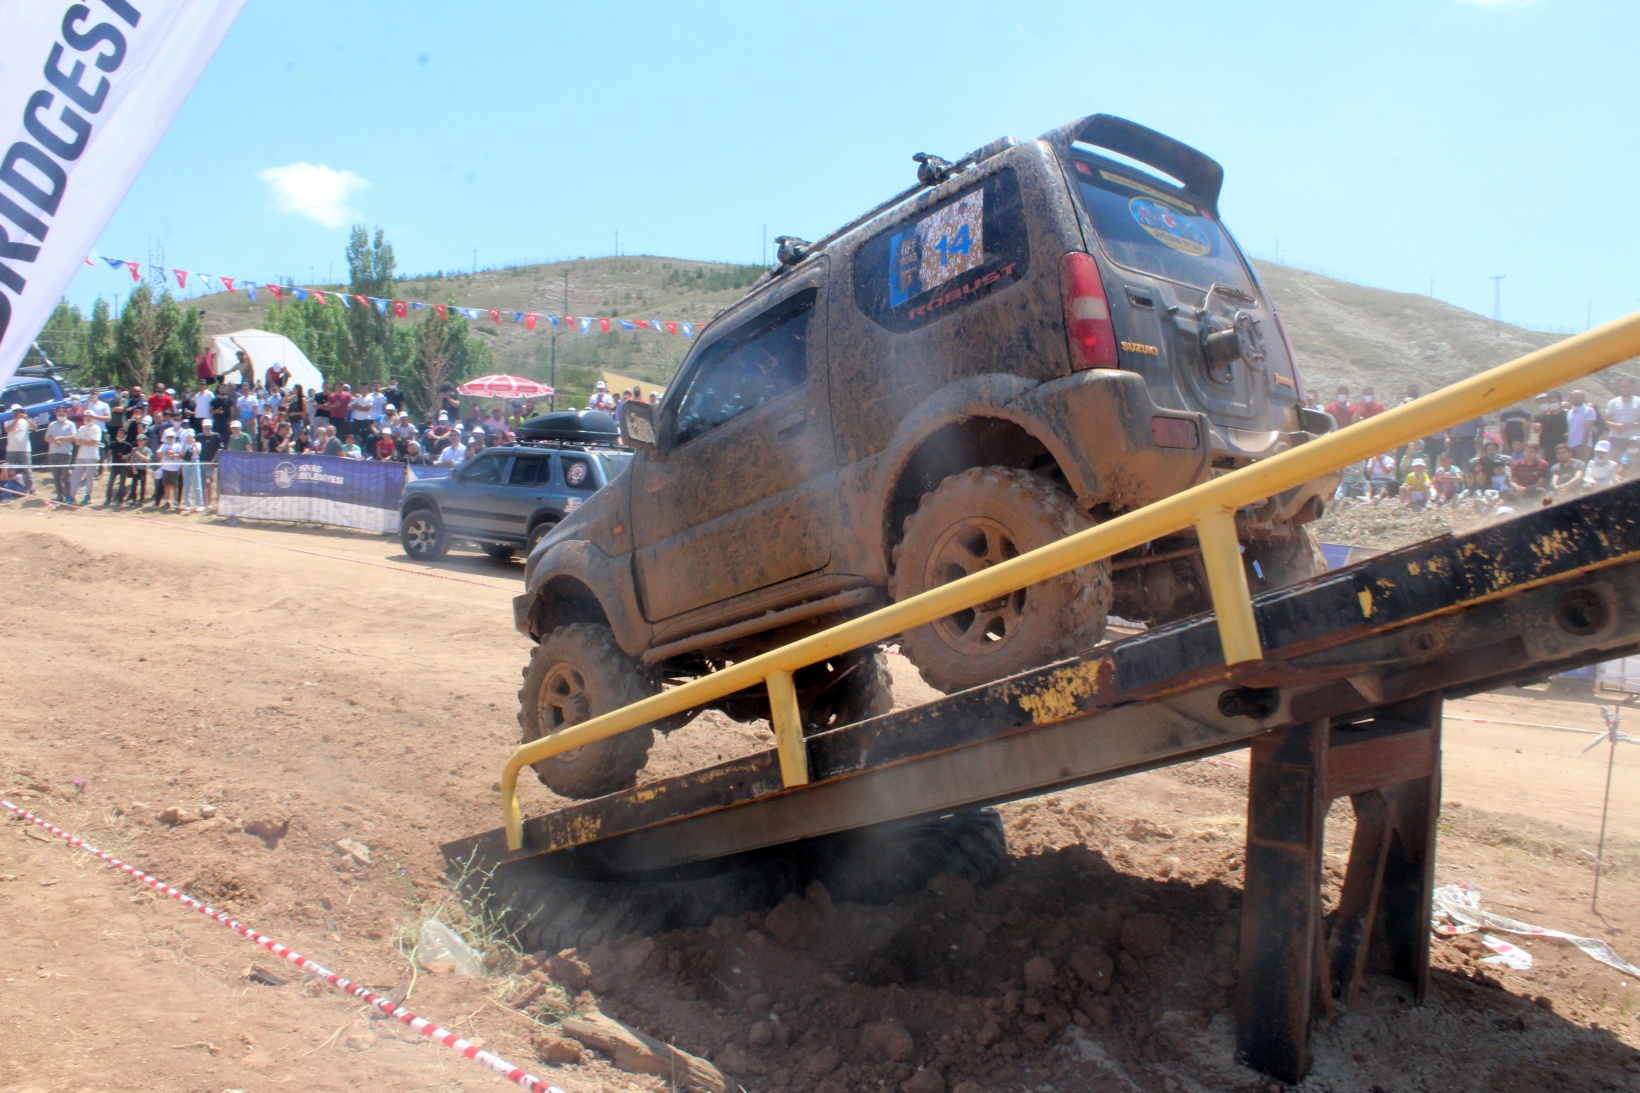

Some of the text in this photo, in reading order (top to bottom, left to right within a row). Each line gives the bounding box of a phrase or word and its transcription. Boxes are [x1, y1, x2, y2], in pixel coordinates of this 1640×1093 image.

[0, 0, 142, 346] RIDGES
[935, 224, 972, 266] 14
[909, 263, 1016, 320] ROBUST
